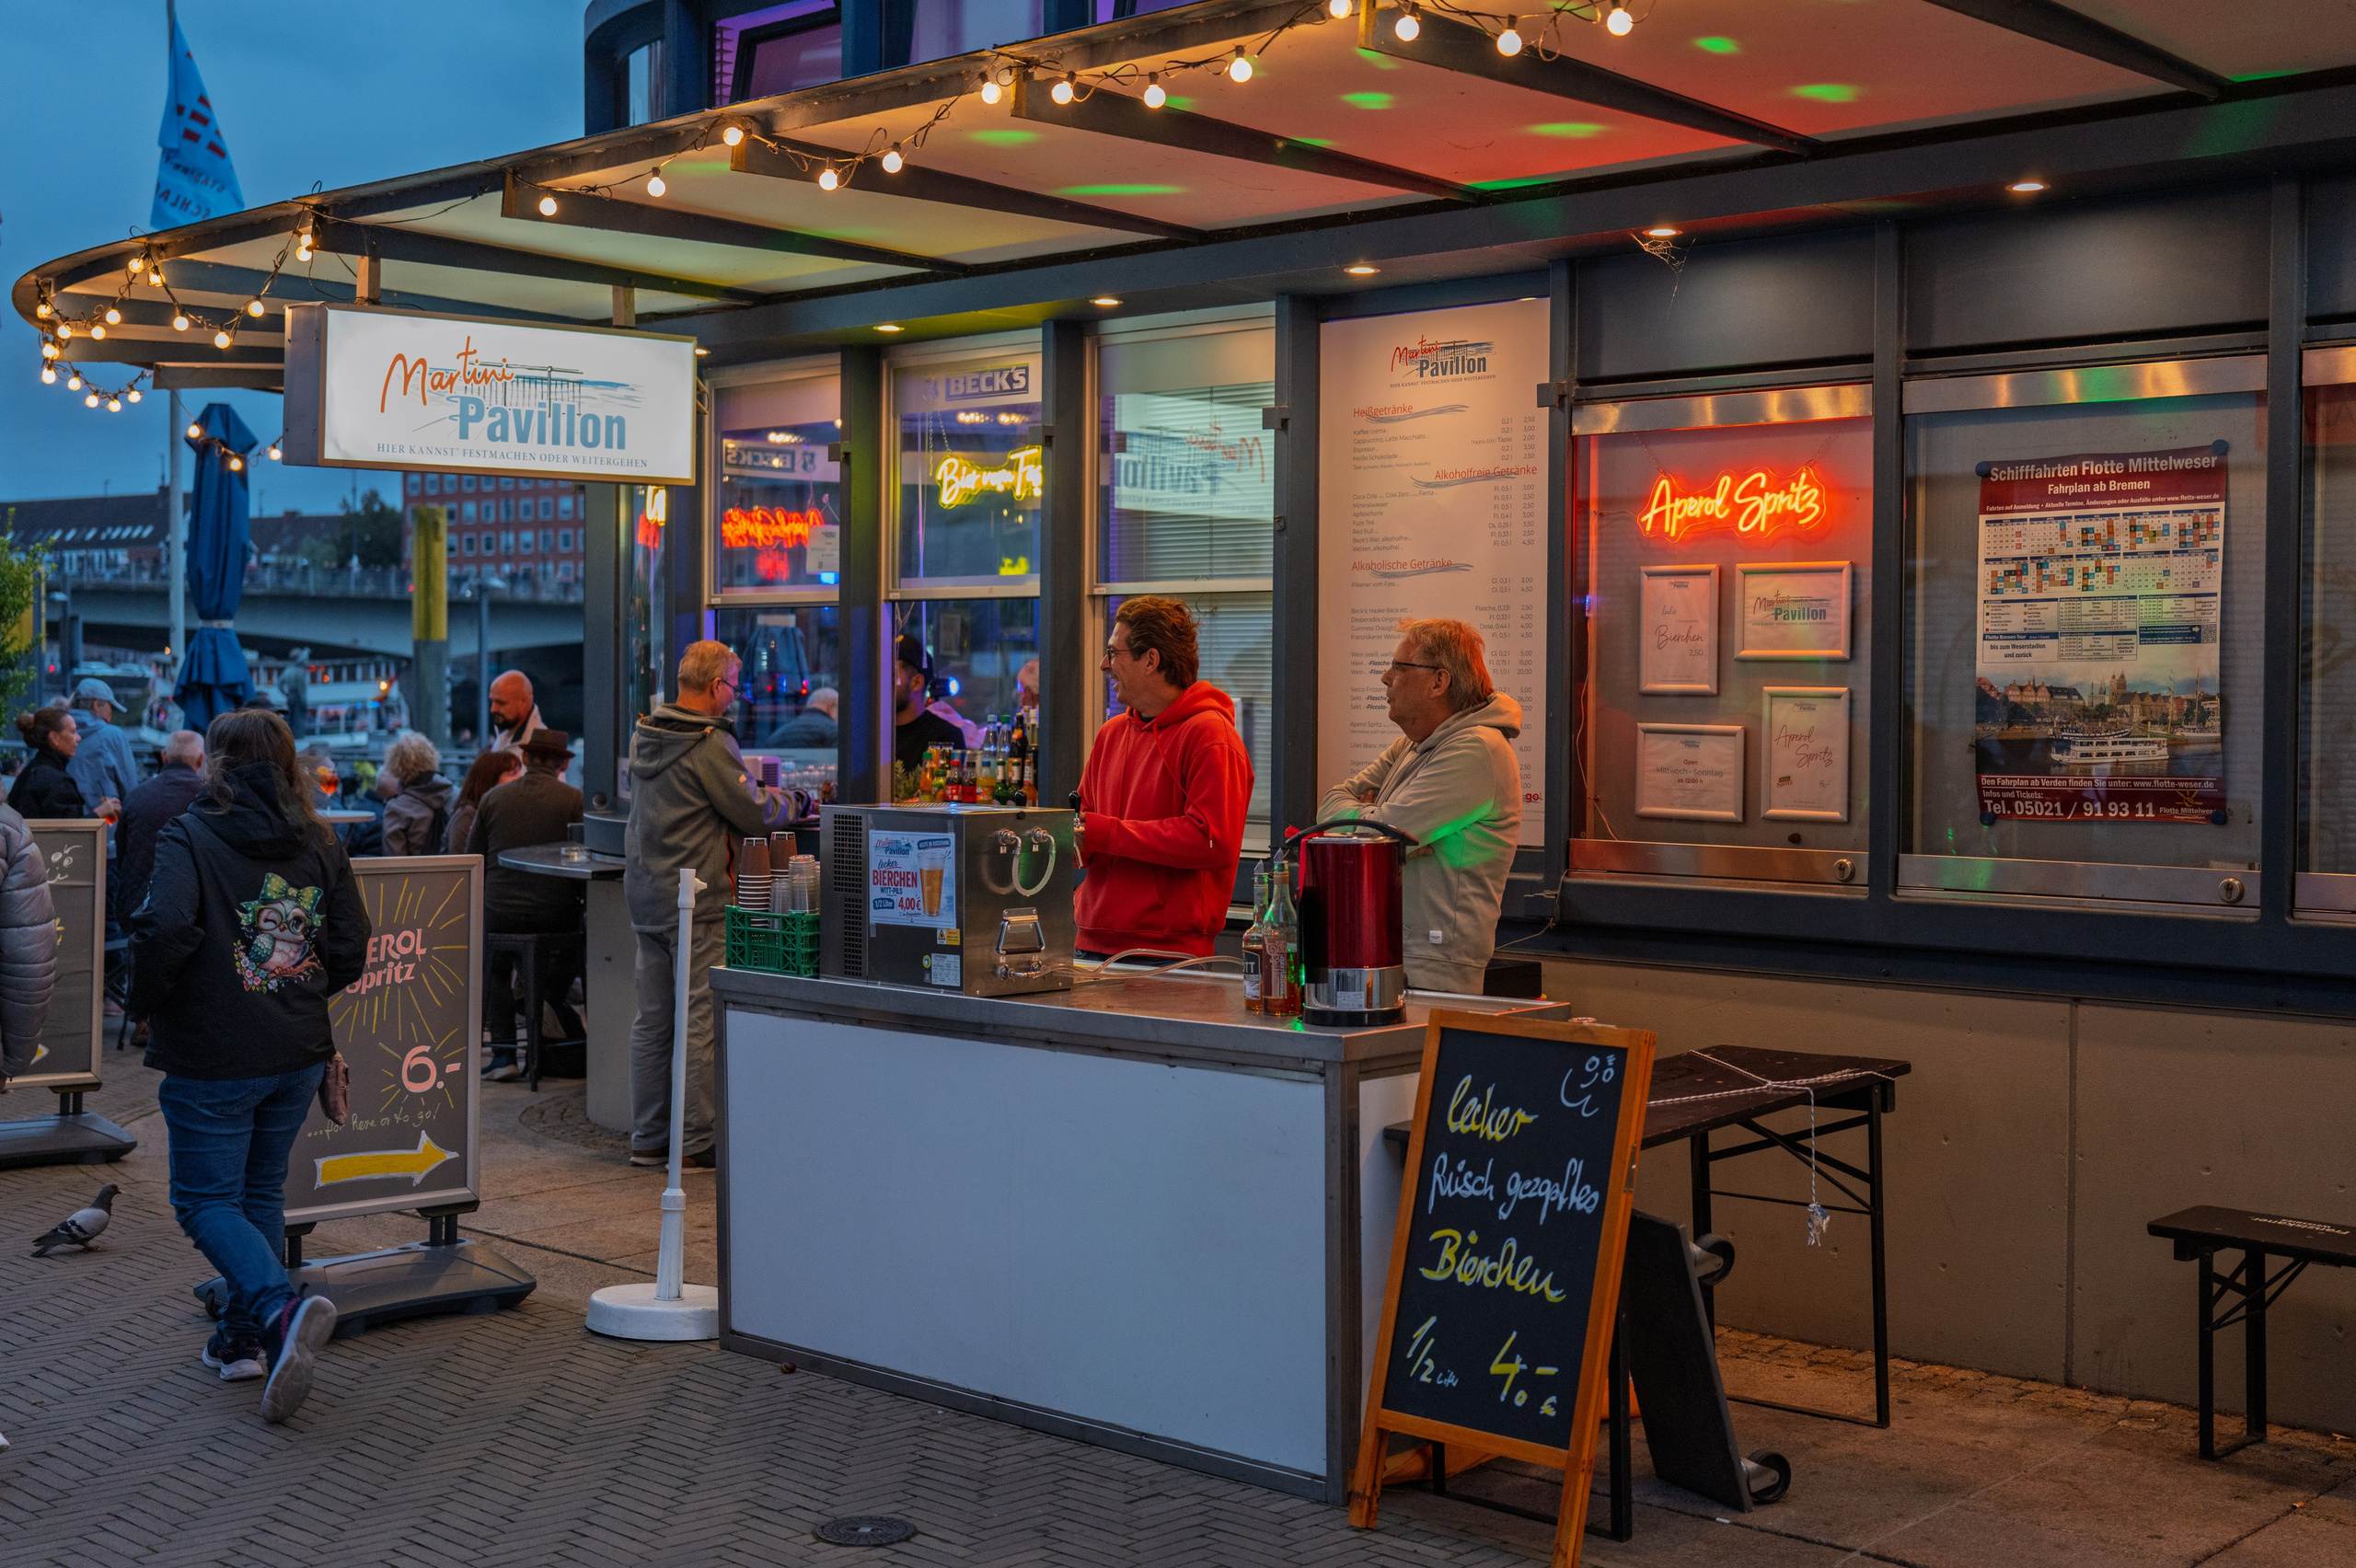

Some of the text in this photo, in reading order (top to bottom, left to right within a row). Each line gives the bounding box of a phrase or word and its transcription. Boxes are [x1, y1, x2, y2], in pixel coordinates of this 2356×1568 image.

[1391, 334, 1441, 372] Martini
[380, 335, 514, 414] Martini
[1419, 356, 1487, 378] Pavillon
[949, 366, 1026, 396] BECK'S
[1353, 404, 1413, 419] Heißgetränke
[458, 395, 627, 451] Pavillon
[376, 443, 406, 455] HIER
[462, 448, 537, 462] FESTMACHEN
[539, 452, 570, 464] ODER
[572, 455, 649, 468] WEITERGEHEN
[1353, 446, 1375, 454] Espresso
[1434, 464, 1538, 480] Alkoholfreie Getränke
[1990, 455, 2218, 482] Schifffahrten Flotte Mittelweser
[937, 457, 980, 504] Bier
[2048, 480, 2151, 496] Fahrplan ab Bremen
[1640, 467, 1820, 537] Aperol Spritz
[2014, 502, 2040, 511] Anmeldung
[2086, 497, 2117, 506] Änderungen
[2167, 493, 2220, 502] www.flotte-weser.de
[1351, 558, 1452, 571] Alkoholische Getränke
[1753, 589, 1792, 616] Martini
[1774, 607, 1827, 621] Pavillon
[1654, 624, 1703, 650] Bierchen
[1774, 724, 1815, 749] Aperol
[1795, 744, 1834, 768] Spritz
[1656, 767, 1724, 778] Mittwoch Sonntag
[1981, 778, 2214, 789] Den Fahrplan ab Verden finden Sie unter: www.flotte-weser.de
[1982, 790, 2044, 800] Infos und Tickets:
[1985, 801, 2155, 819] Tel. 05021 / 91 93 11
[2180, 807, 2216, 815] Mittelwes
[885, 846, 910, 856] Pavillon
[878, 859, 898, 870] lecker
[872, 870, 918, 888] BIERCHEN
[883, 899, 893, 907] Liter
[898, 897, 916, 912] 4,00
[916, 899, 921, 911] €
[367, 928, 427, 965] EROL
[352, 1113, 376, 1131] here
[380, 1117, 391, 1126] or
[394, 1106, 410, 1124] to
[412, 1102, 441, 1127] go!
[1420, 1228, 1566, 1304] Bierchen
